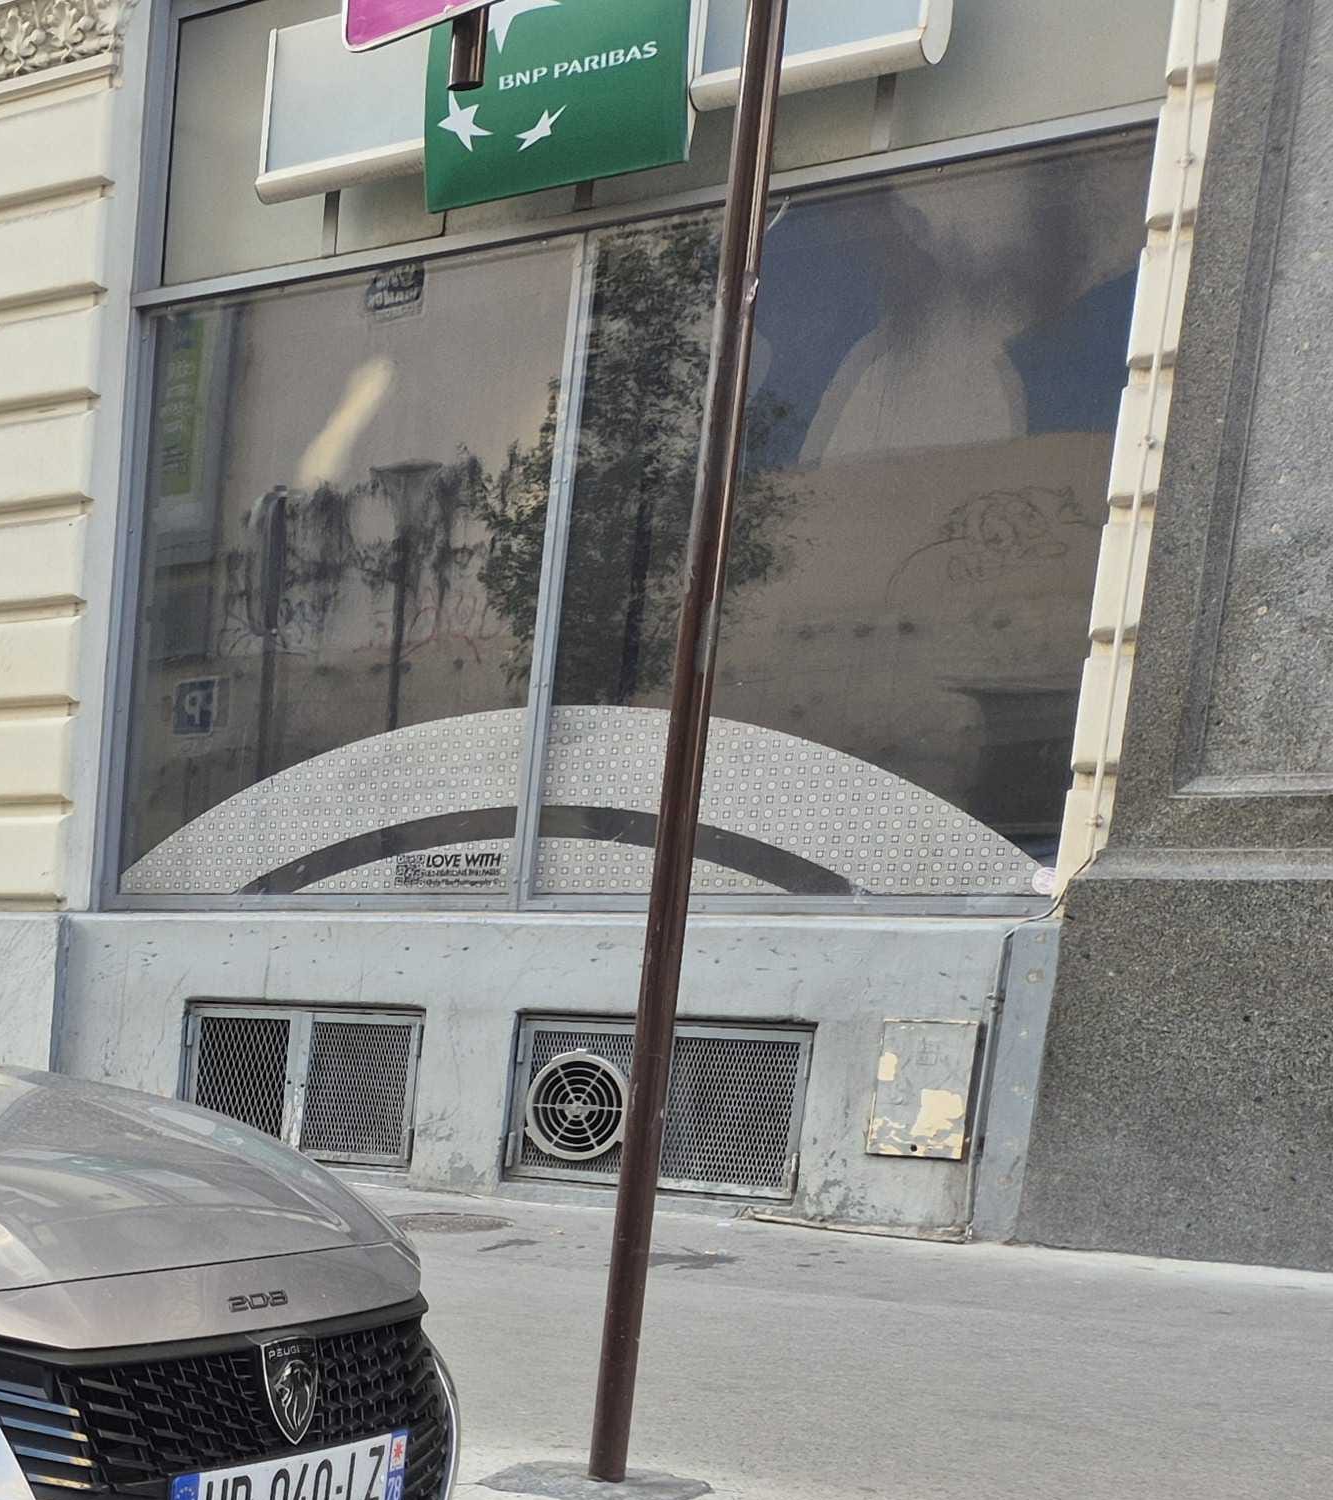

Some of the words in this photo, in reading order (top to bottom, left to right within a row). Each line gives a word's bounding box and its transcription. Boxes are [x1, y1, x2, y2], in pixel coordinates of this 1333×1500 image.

[498, 67, 549, 91] BNP
[553, 41, 659, 77] PARIBAS
[426, 853, 462, 868] LOVE
[465, 852, 502, 867] WITH
[227, 1289, 289, 1312] 208
